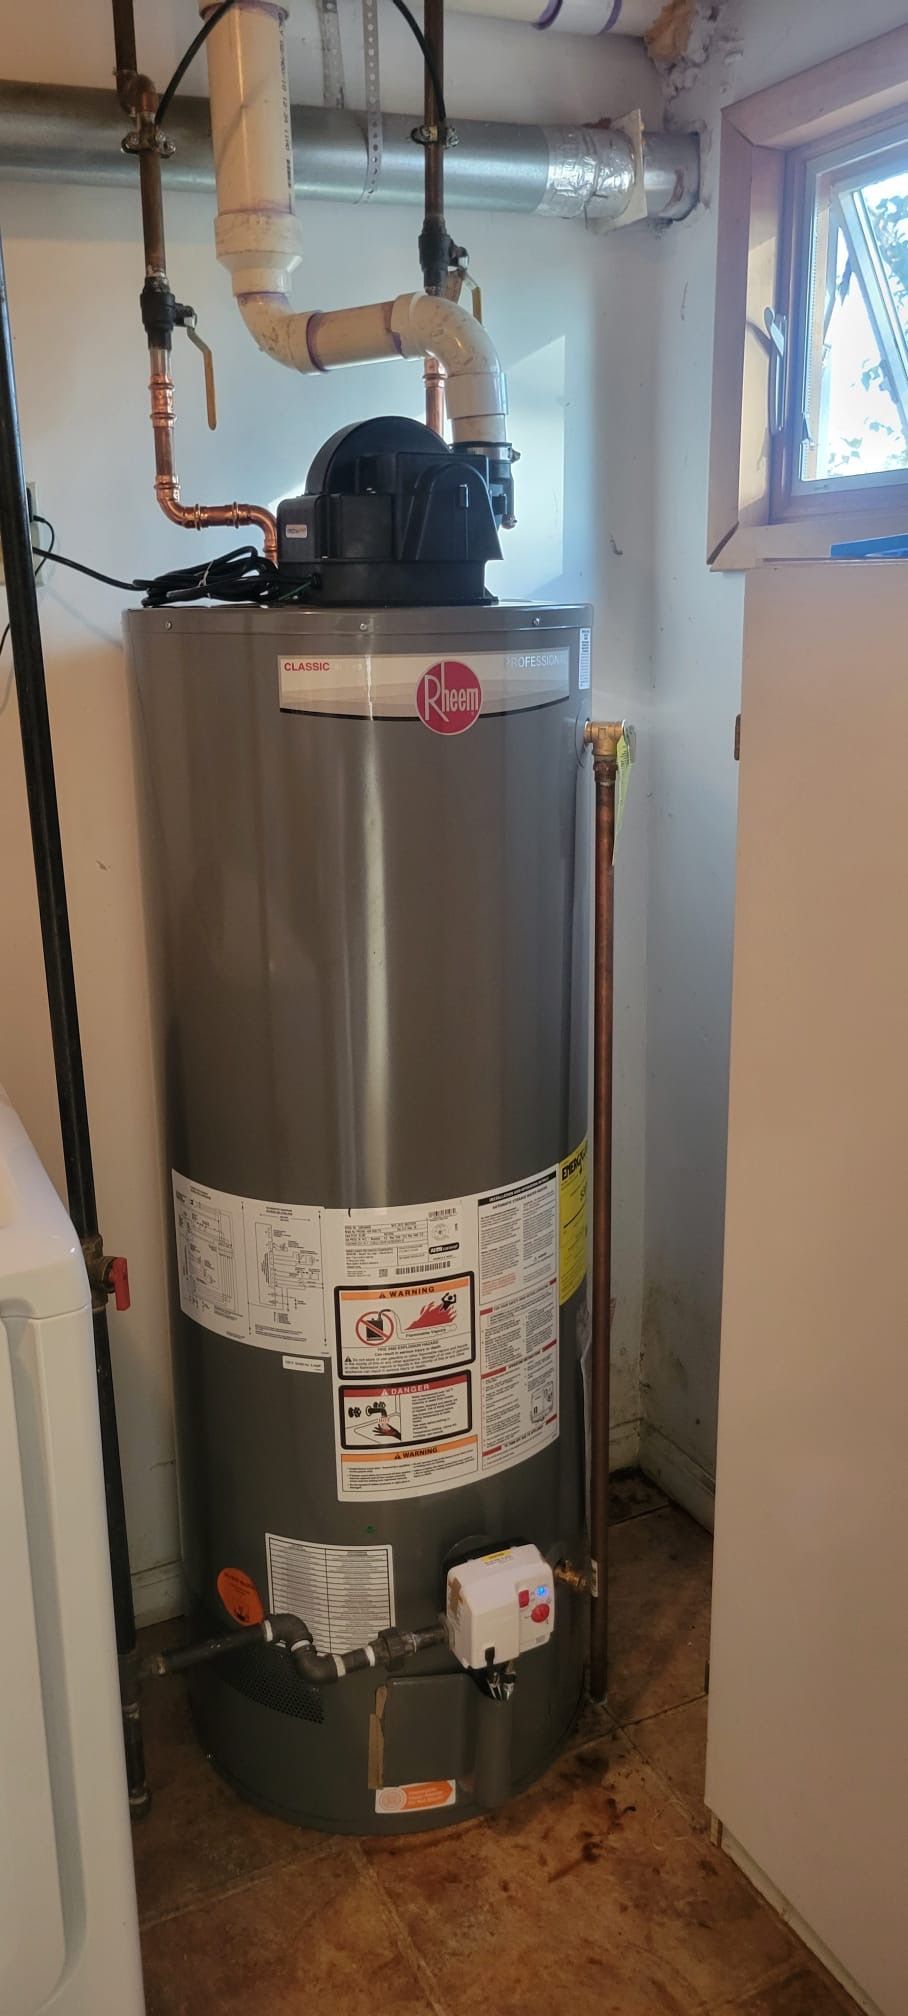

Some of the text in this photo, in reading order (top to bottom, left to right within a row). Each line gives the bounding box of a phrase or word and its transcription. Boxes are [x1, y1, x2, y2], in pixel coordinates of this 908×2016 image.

[284, 662, 330, 672] CLASSIC
[424, 661, 479, 722] Rheem
[389, 1286, 435, 1298] WARNING
[391, 1383, 430, 1395] DANGER
[402, 1447, 438, 1458] WARNING
